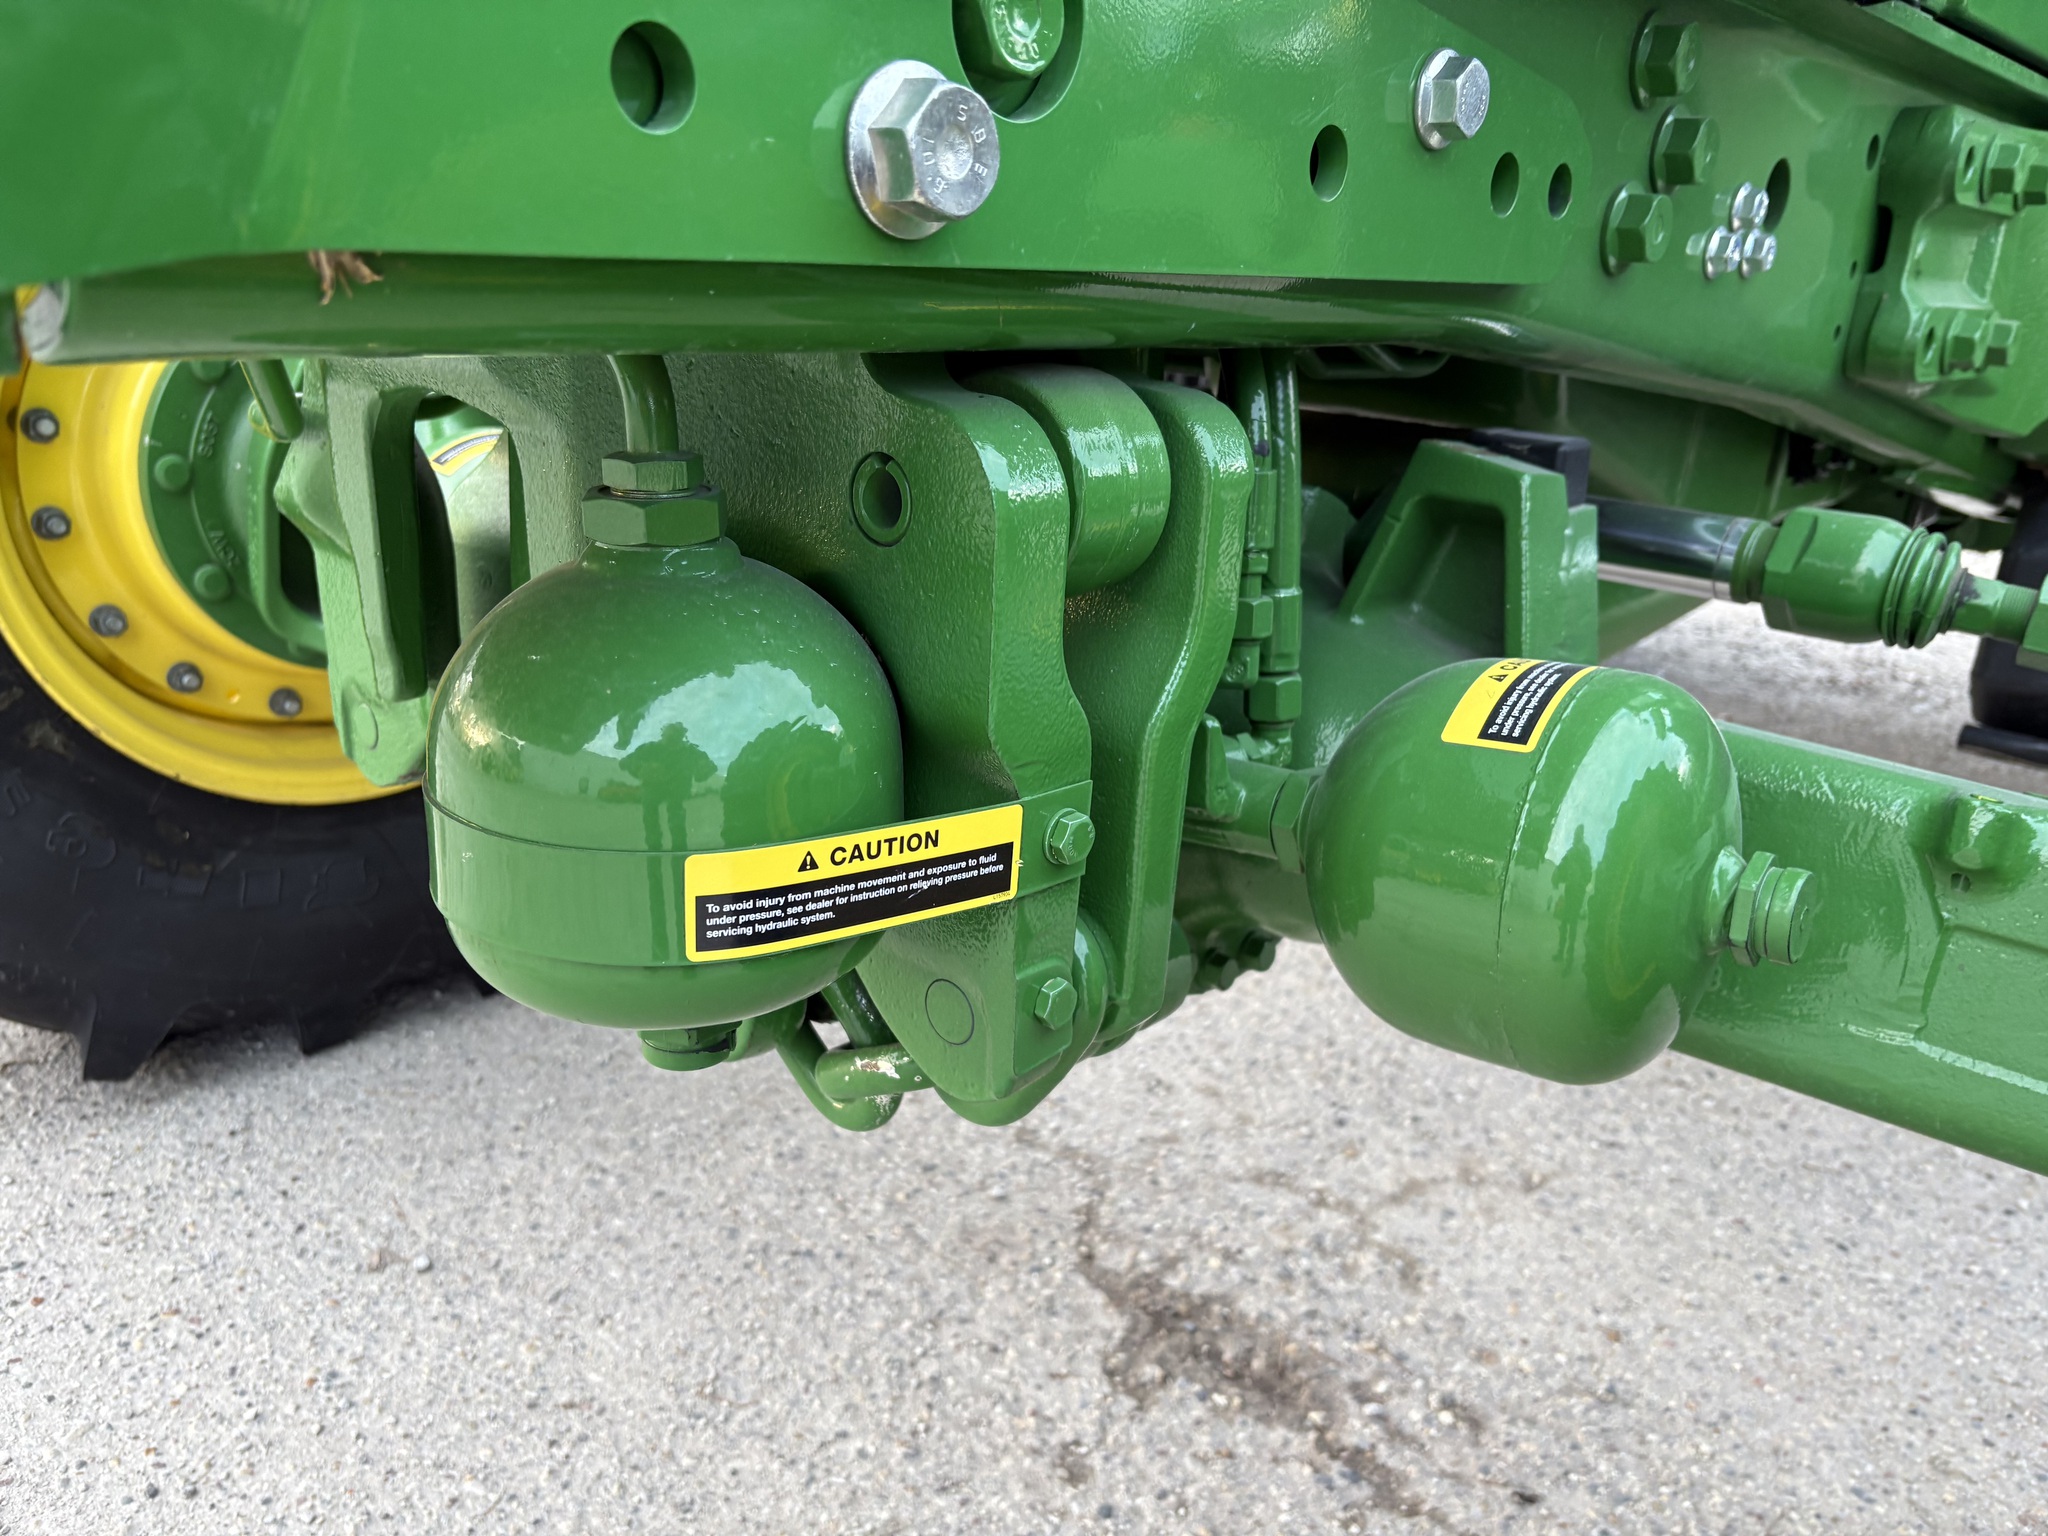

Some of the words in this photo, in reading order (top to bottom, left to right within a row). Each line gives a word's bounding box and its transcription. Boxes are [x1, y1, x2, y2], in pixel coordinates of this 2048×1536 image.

[1488, 724, 1500, 734] To
[1495, 705, 1511, 725] avoid
[1501, 715, 1516, 736] under
[1512, 709, 1534, 738] servicing
[830, 829, 939, 866] CAUTION
[706, 903, 720, 913] To
[723, 899, 753, 912] avoid
[756, 895, 785, 909] injury
[788, 890, 812, 902] from
[814, 883, 856, 898] machine
[858, 873, 907, 890] movement
[908, 867, 925, 879] and
[927, 861, 967, 878] exposure
[968, 858, 977, 867] to
[979, 853, 997, 865] fluid
[706, 914, 737, 926] under
[739, 909, 785, 924] pressure,
[787, 905, 804, 915] see
[805, 899, 834, 911] dealer
[835, 895, 849, 905] for
[850, 885, 896, 903] instruction
[897, 883, 908, 893] on
[910, 877, 943, 891] relieving
[945, 869, 978, 884] pressure
[980, 863, 1004, 875] before
[706, 924, 753, 938] servicing
[755, 918, 799, 933] hydraulic
[800, 910, 836, 924] system.
